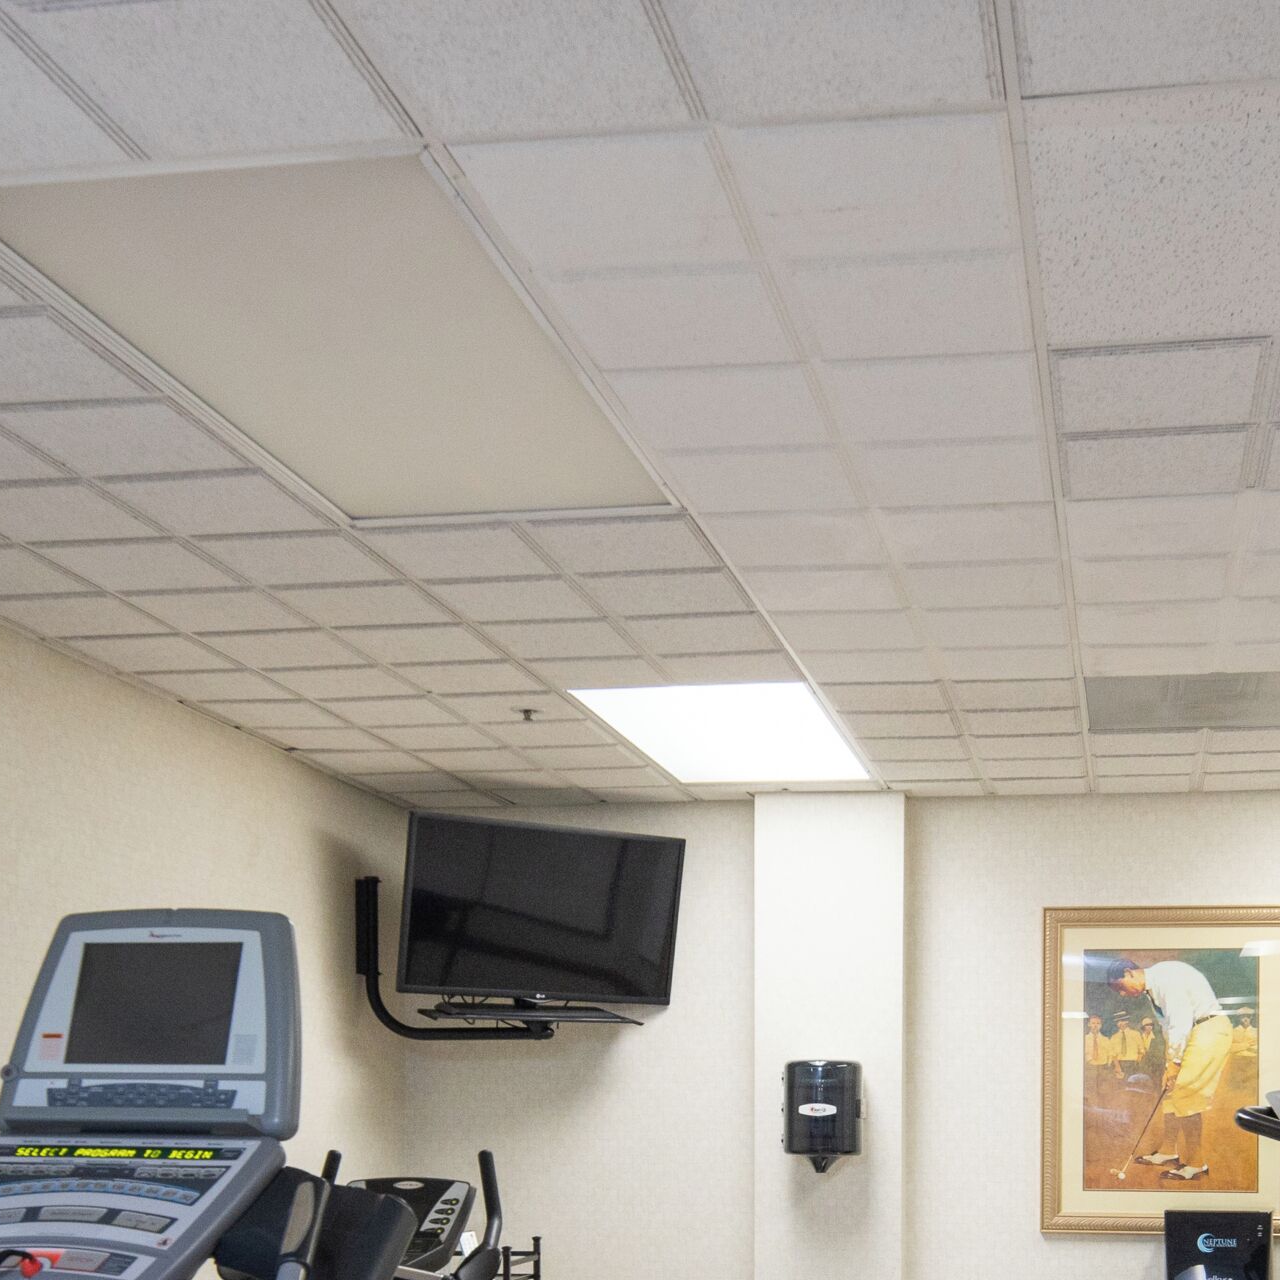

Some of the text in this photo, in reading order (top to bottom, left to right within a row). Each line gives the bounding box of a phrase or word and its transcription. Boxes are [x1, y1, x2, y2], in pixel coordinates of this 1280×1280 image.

[15, 1147, 214, 1160] SELECT PROGRAM TO BEGIN
[1203, 1238, 1238, 1246] NEPTUNE
